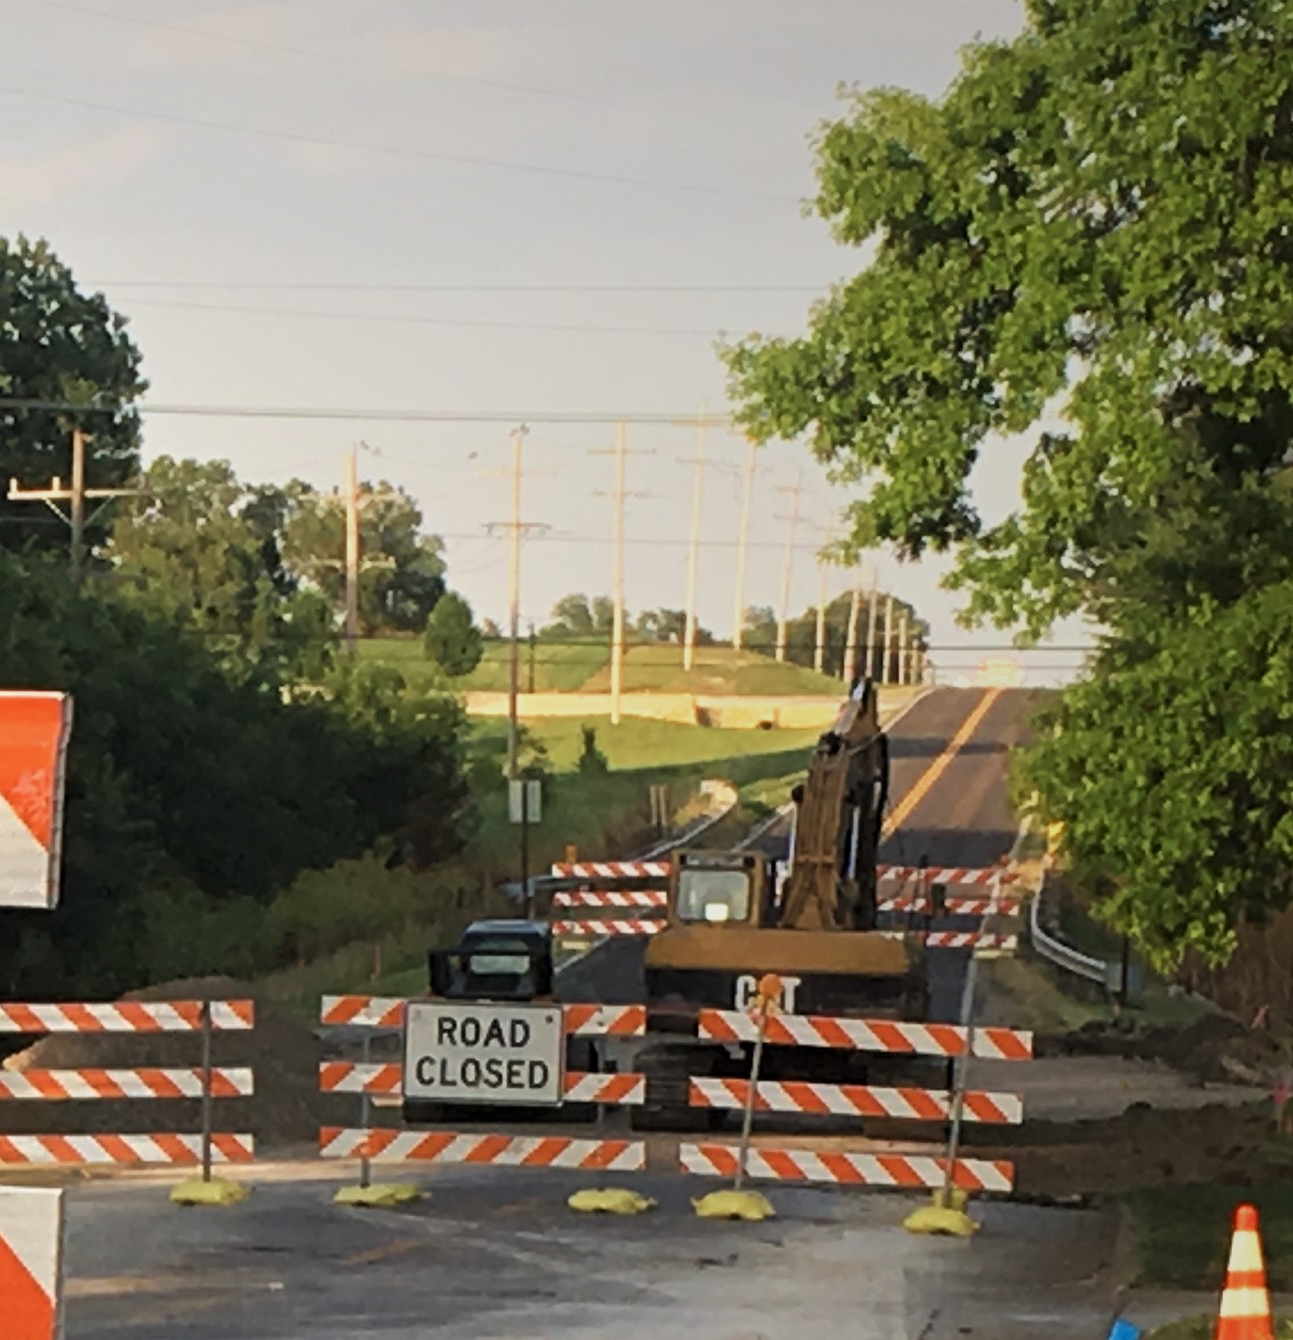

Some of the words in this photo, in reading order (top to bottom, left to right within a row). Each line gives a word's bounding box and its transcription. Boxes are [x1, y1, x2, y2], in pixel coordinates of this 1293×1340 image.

[735, 975, 802, 1015] CT
[437, 1016, 531, 1048] ROAD
[415, 1055, 549, 1090] CLOSED
